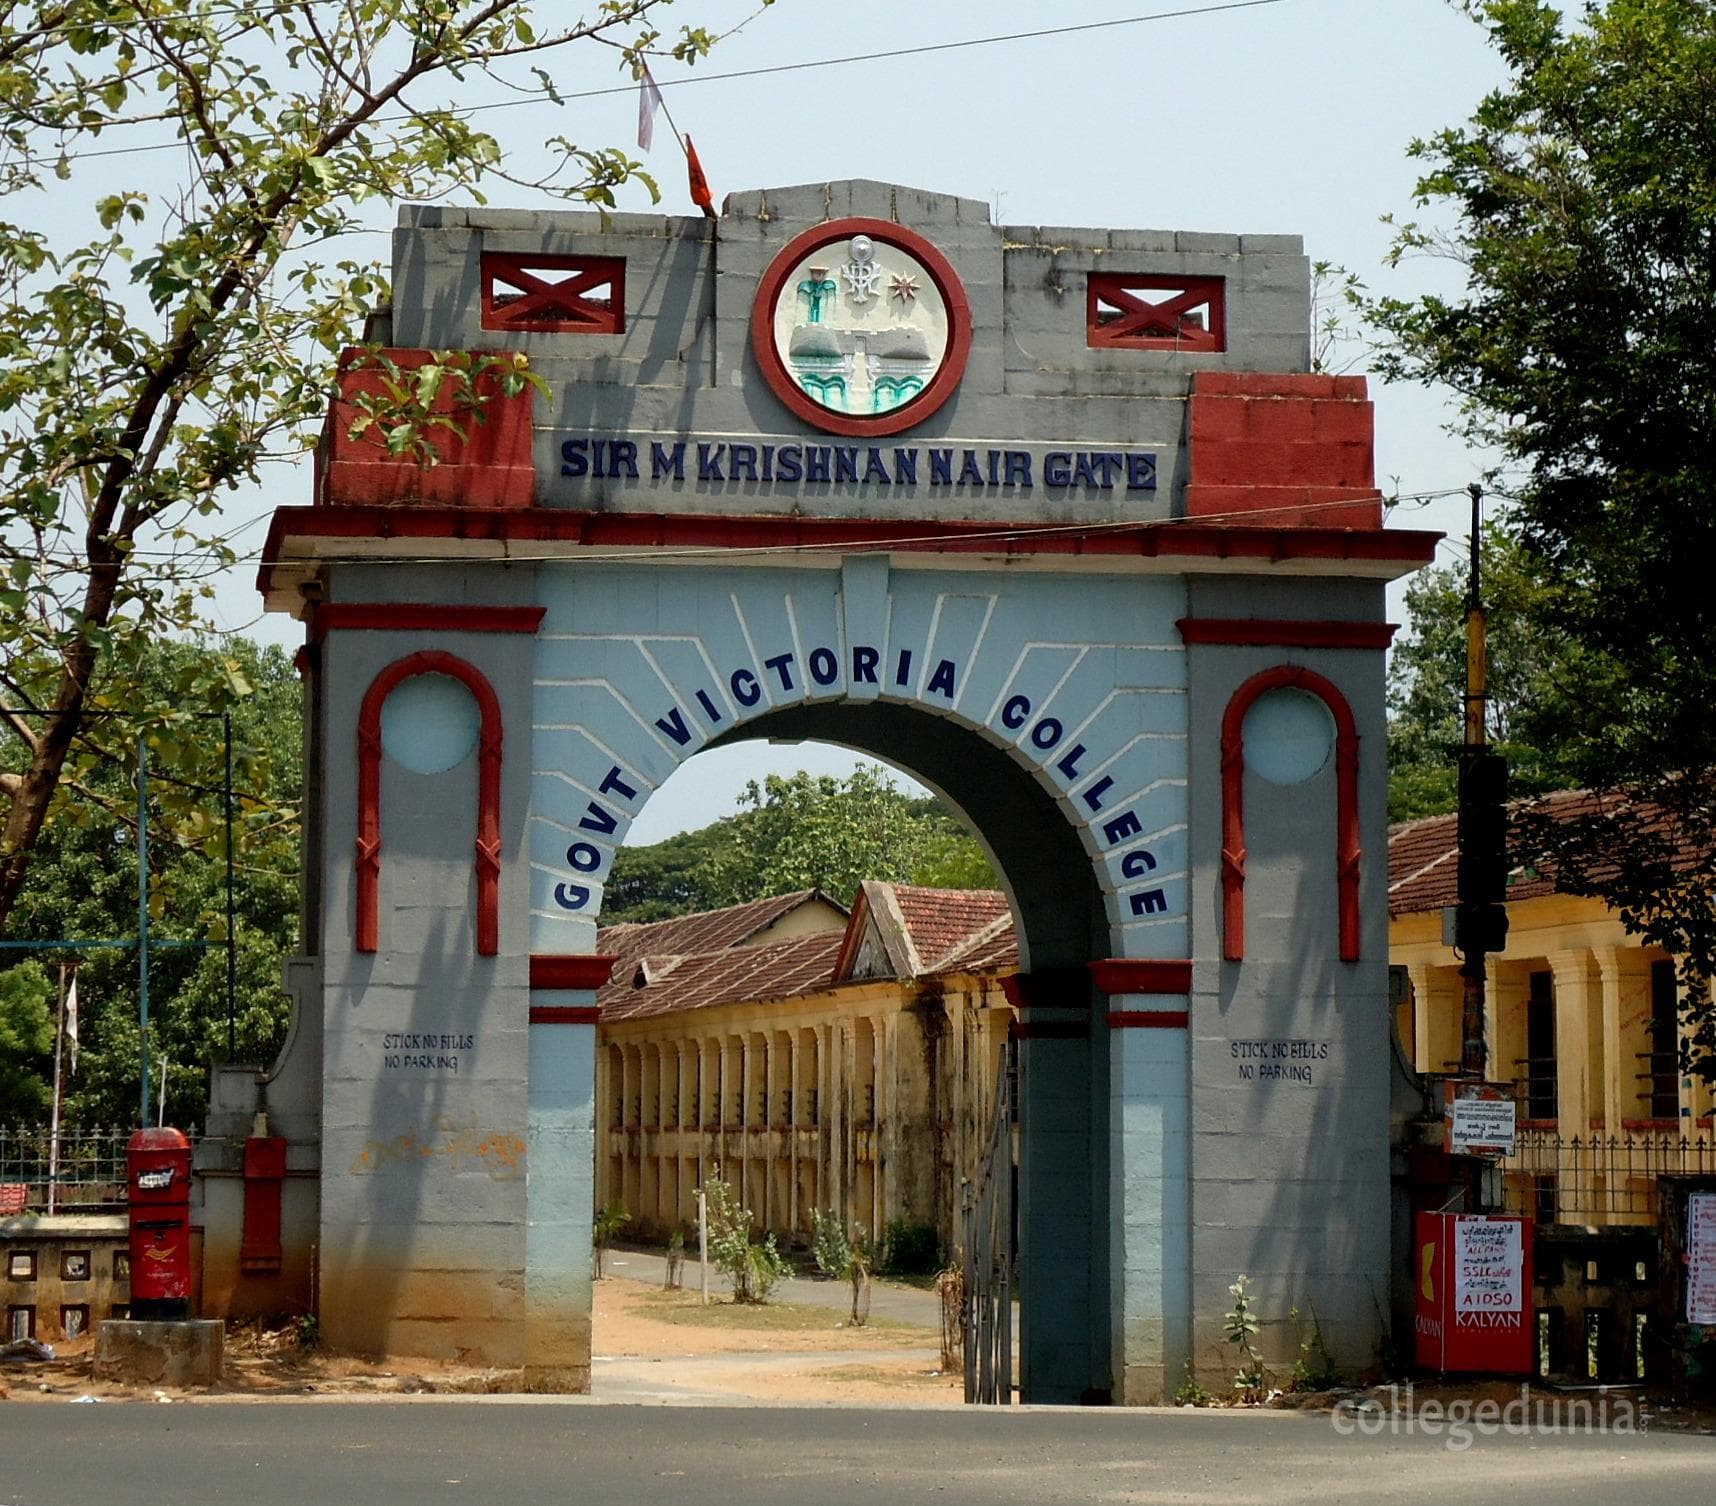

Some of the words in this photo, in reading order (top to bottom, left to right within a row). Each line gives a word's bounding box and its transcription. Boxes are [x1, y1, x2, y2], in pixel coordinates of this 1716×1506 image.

[560, 437, 639, 478] SIR
[651, 441, 685, 480] M
[699, 443, 918, 485] KRISHNAN
[929, 448, 1033, 488] NAIR
[1043, 451, 1157, 490] GATE
[654, 646, 956, 747] VICTORIA
[1002, 694, 1168, 917] COLLEGE
[554, 765, 638, 910] GOVT
[383, 1034, 420, 1050] STICK
[422, 1034, 438, 1049] NO
[440, 1034, 474, 1050] BILLS
[1231, 1042, 1268, 1058] STICK
[1271, 1042, 1288, 1059] NO
[1290, 1041, 1328, 1059] BILLS
[384, 1055, 401, 1069] NO
[404, 1055, 458, 1073] PARKING
[1239, 1064, 1254, 1080] NO
[1260, 1064, 1312, 1085] PARKING
[1463, 1292, 1513, 1306] AIDSO
[1456, 1312, 1520, 1328] KALYAN
